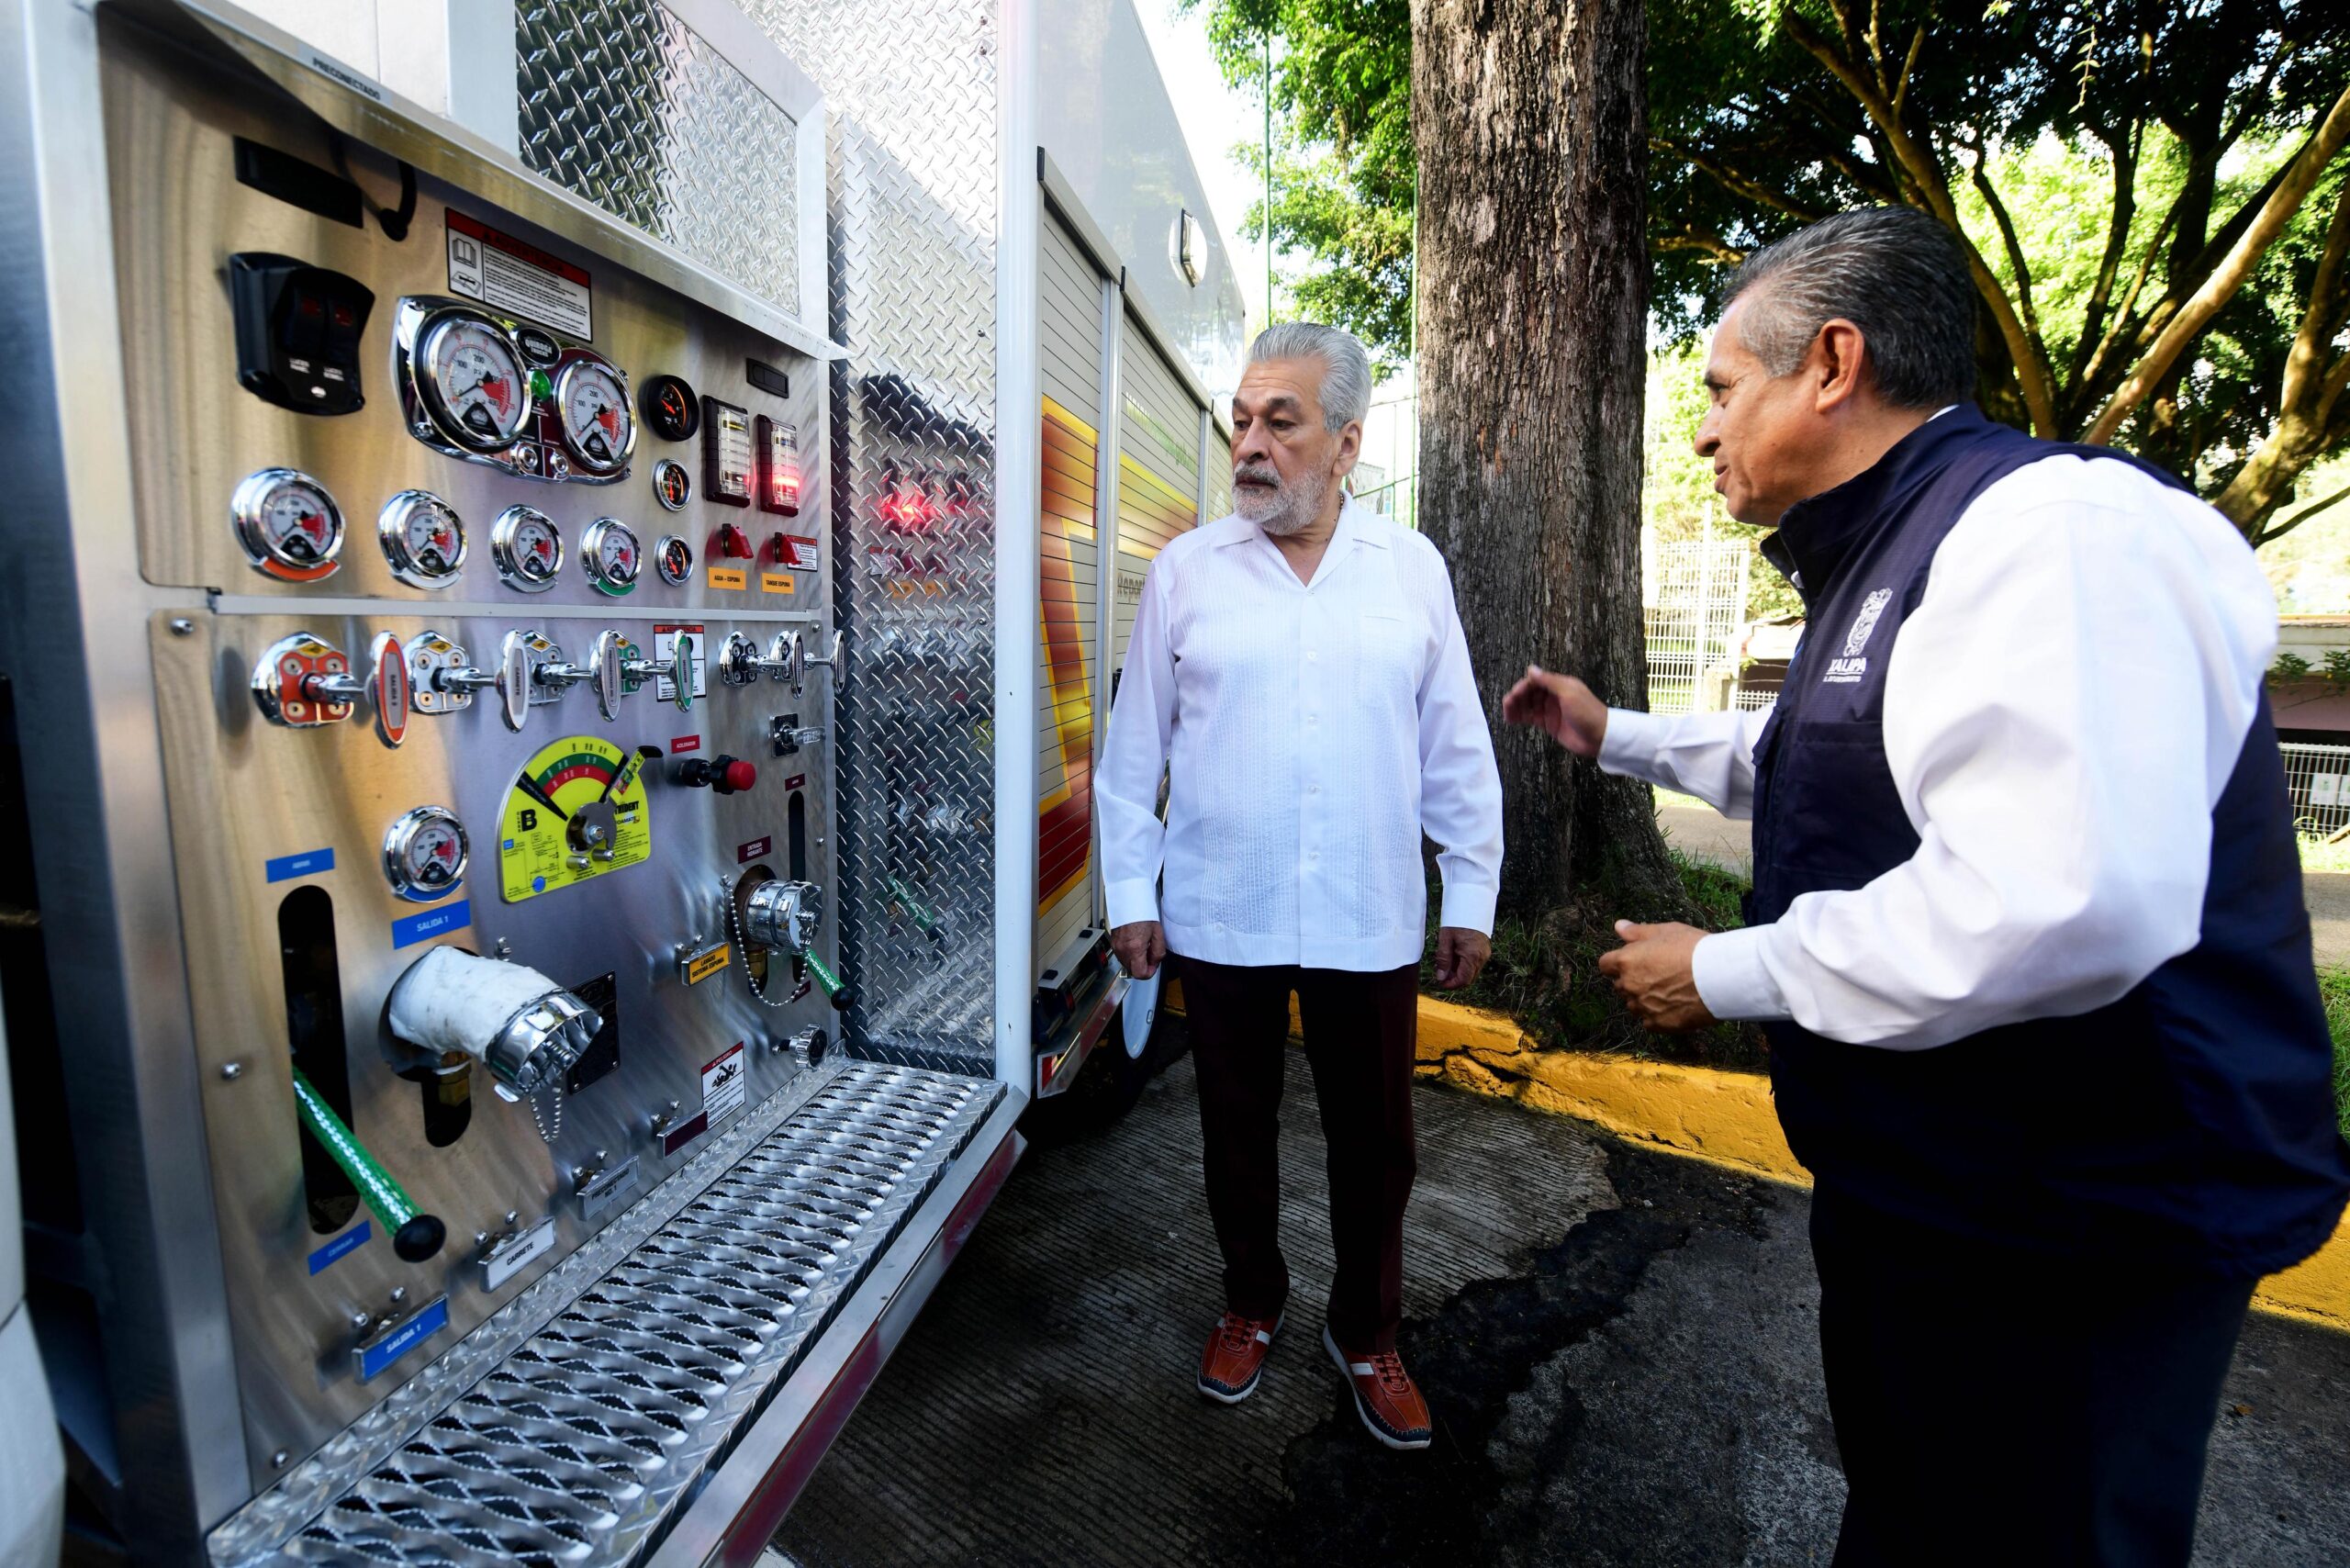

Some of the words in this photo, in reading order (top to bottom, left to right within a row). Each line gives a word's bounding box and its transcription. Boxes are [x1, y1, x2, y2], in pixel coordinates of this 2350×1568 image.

[313, 57, 381, 100] PRECONECTADO
[1828, 657, 1866, 672] XALAPA
[520, 809, 538, 832] B
[417, 917, 442, 932] SALIDA
[716, 1050, 733, 1064] PELIGRO
[507, 1242, 534, 1266] CARRETE
[386, 1328, 415, 1353] SALIDA
